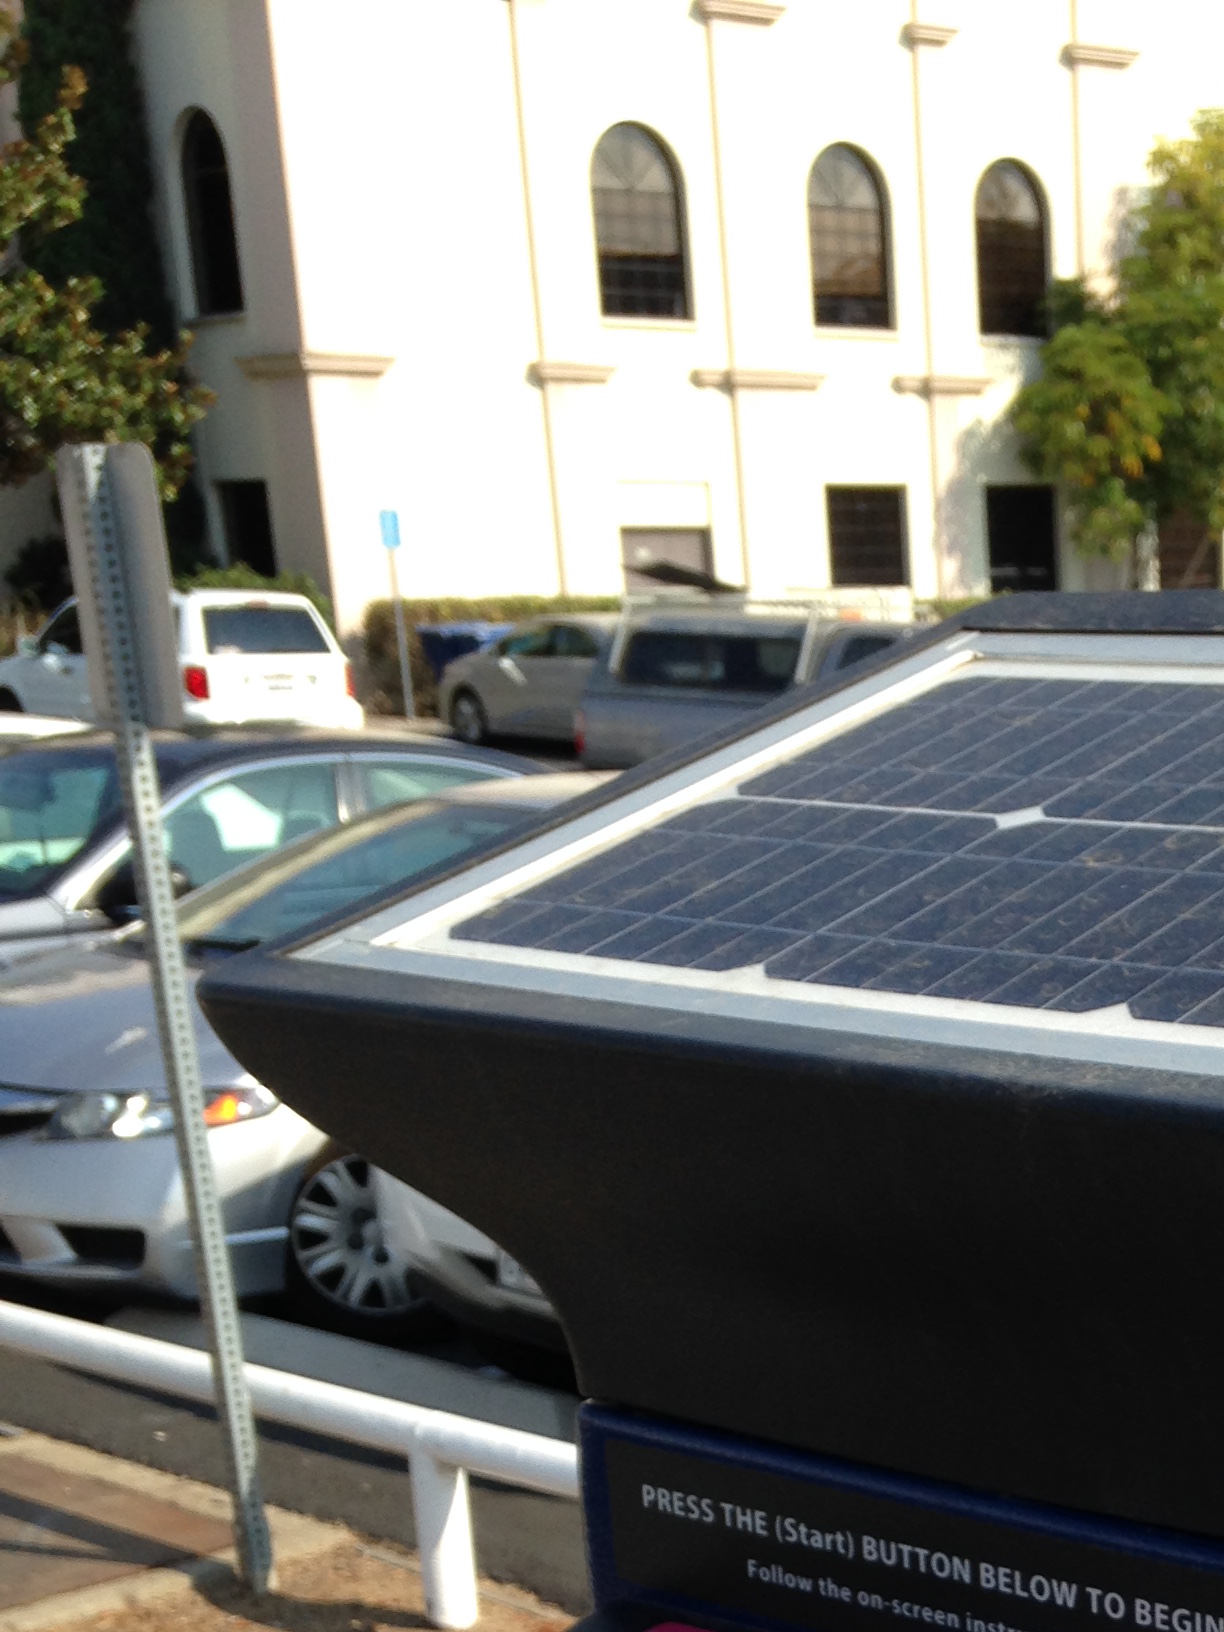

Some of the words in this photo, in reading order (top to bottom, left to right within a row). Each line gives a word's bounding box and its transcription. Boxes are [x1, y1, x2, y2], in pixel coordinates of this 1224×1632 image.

[641, 1484, 715, 1525] PRESS
[721, 1503, 769, 1539] THE
[774, 1514, 856, 1560] (Start)
[862, 1535, 972, 1586] BUTTON
[979, 1562, 1078, 1609] BELOW
[1085, 1586, 1126, 1620] TO
[746, 1559, 813, 1595] Follow
[818, 1576, 851, 1605] the
[857, 1591, 960, 1631] on-screen
